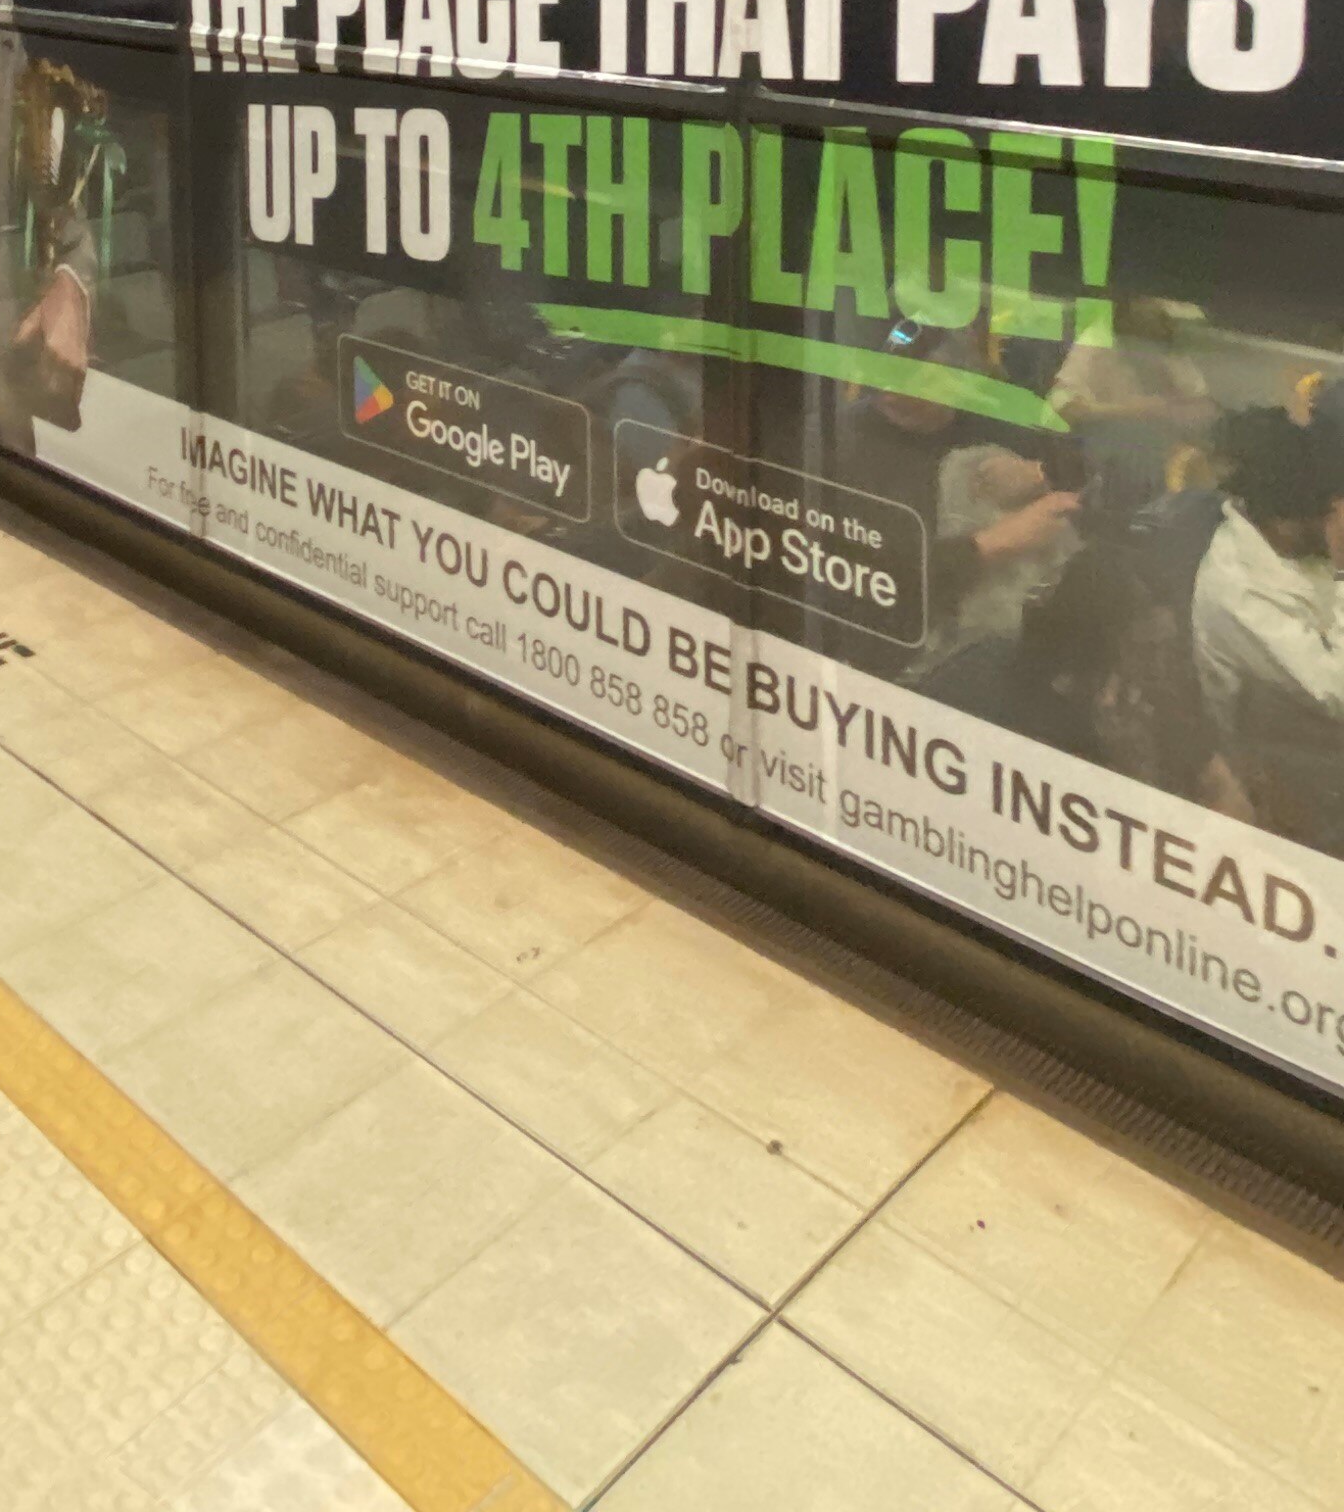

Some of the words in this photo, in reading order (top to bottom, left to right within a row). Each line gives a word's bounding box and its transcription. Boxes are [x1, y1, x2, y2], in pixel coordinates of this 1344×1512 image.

[247, 104, 338, 248] UP
[354, 107, 451, 263] TO
[472, 113, 653, 284] 4TH
[681, 118, 1117, 348] PLACE!
[406, 370, 436, 394] GET
[438, 378, 453, 400] IT
[455, 385, 481, 411] ON
[406, 400, 504, 468] Google
[510, 433, 571, 498] Play
[694, 500, 771, 569] App
[781, 528, 897, 607] Store
[696, 467, 799, 521] Download
[806, 508, 834, 533] on
[843, 517, 883, 549] the
[146, 465, 174, 498] For
[216, 501, 249, 534] and
[256, 519, 367, 589] confidential
[374, 573, 459, 631] support
[466, 615, 506, 654] call
[517, 632, 581, 687] 1800
[590, 664, 643, 717] 858
[653, 693, 710, 748] 858
[720, 733, 748, 769] or
[761, 748, 827, 805] visit
[180, 426, 297, 508] IMAGINE
[306, 478, 401, 550] WHAT
[411, 519, 489, 588] YOU
[502, 559, 651, 657] COULD
[668, 626, 733, 696] BE
[746, 662, 968, 796] BUYING
[991, 761, 1341, 959] INSTEAD.
